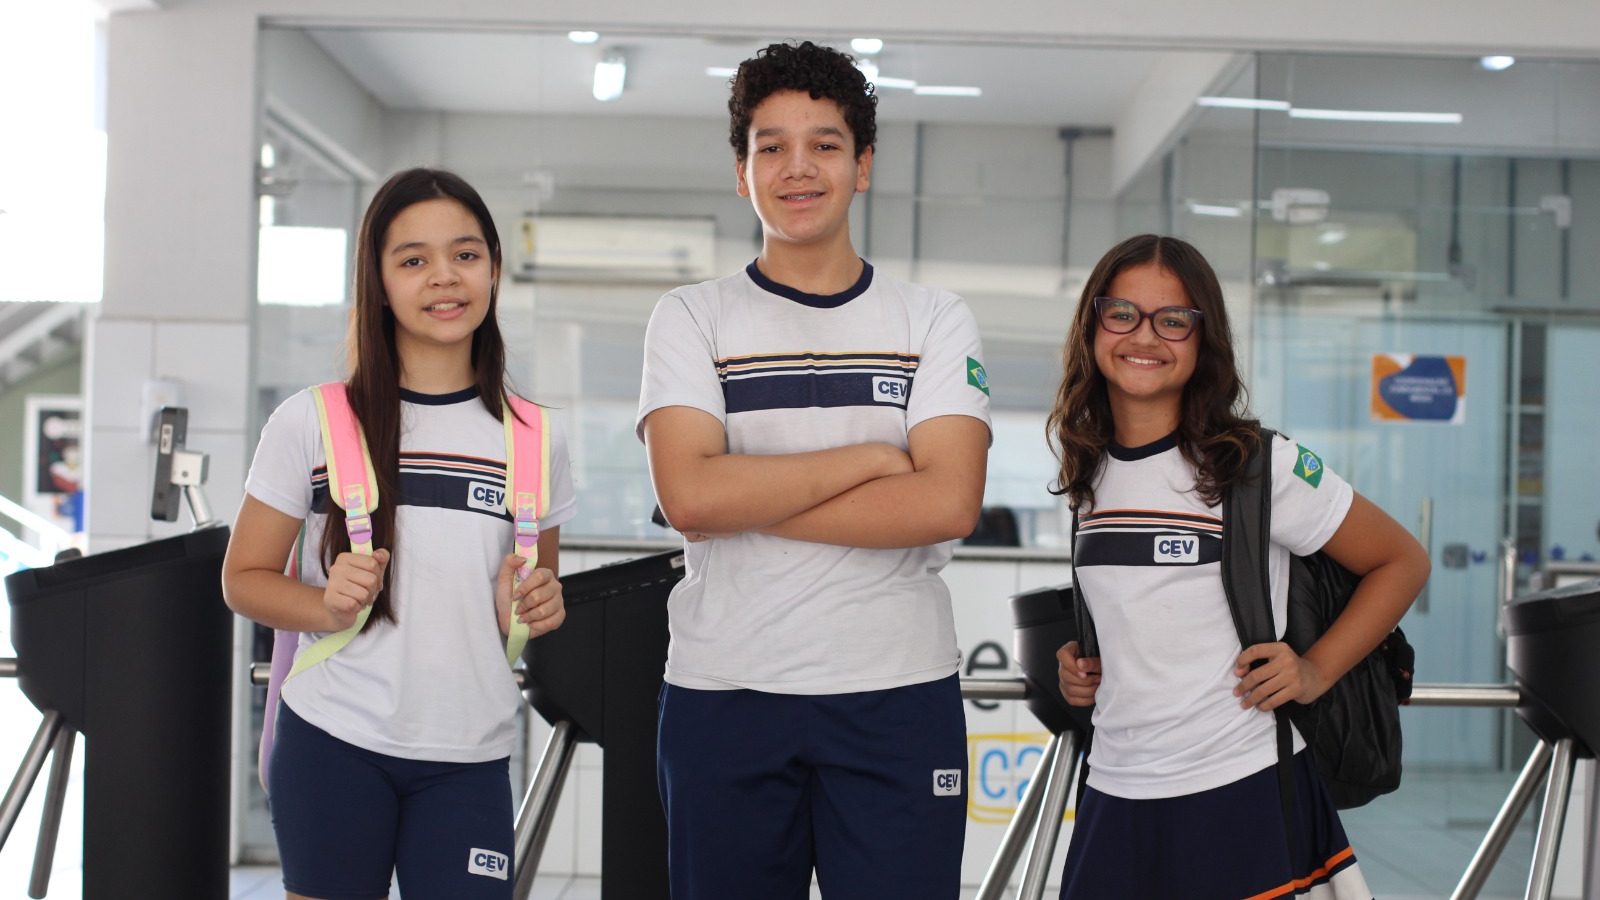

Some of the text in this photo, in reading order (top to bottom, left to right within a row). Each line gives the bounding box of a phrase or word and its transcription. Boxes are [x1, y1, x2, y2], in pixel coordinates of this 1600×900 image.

[878, 380, 907, 397] CEV
[473, 486, 505, 506] CEV
[1158, 540, 1194, 554] CEV
[937, 774, 959, 789] CEV
[474, 853, 505, 872] CEV
